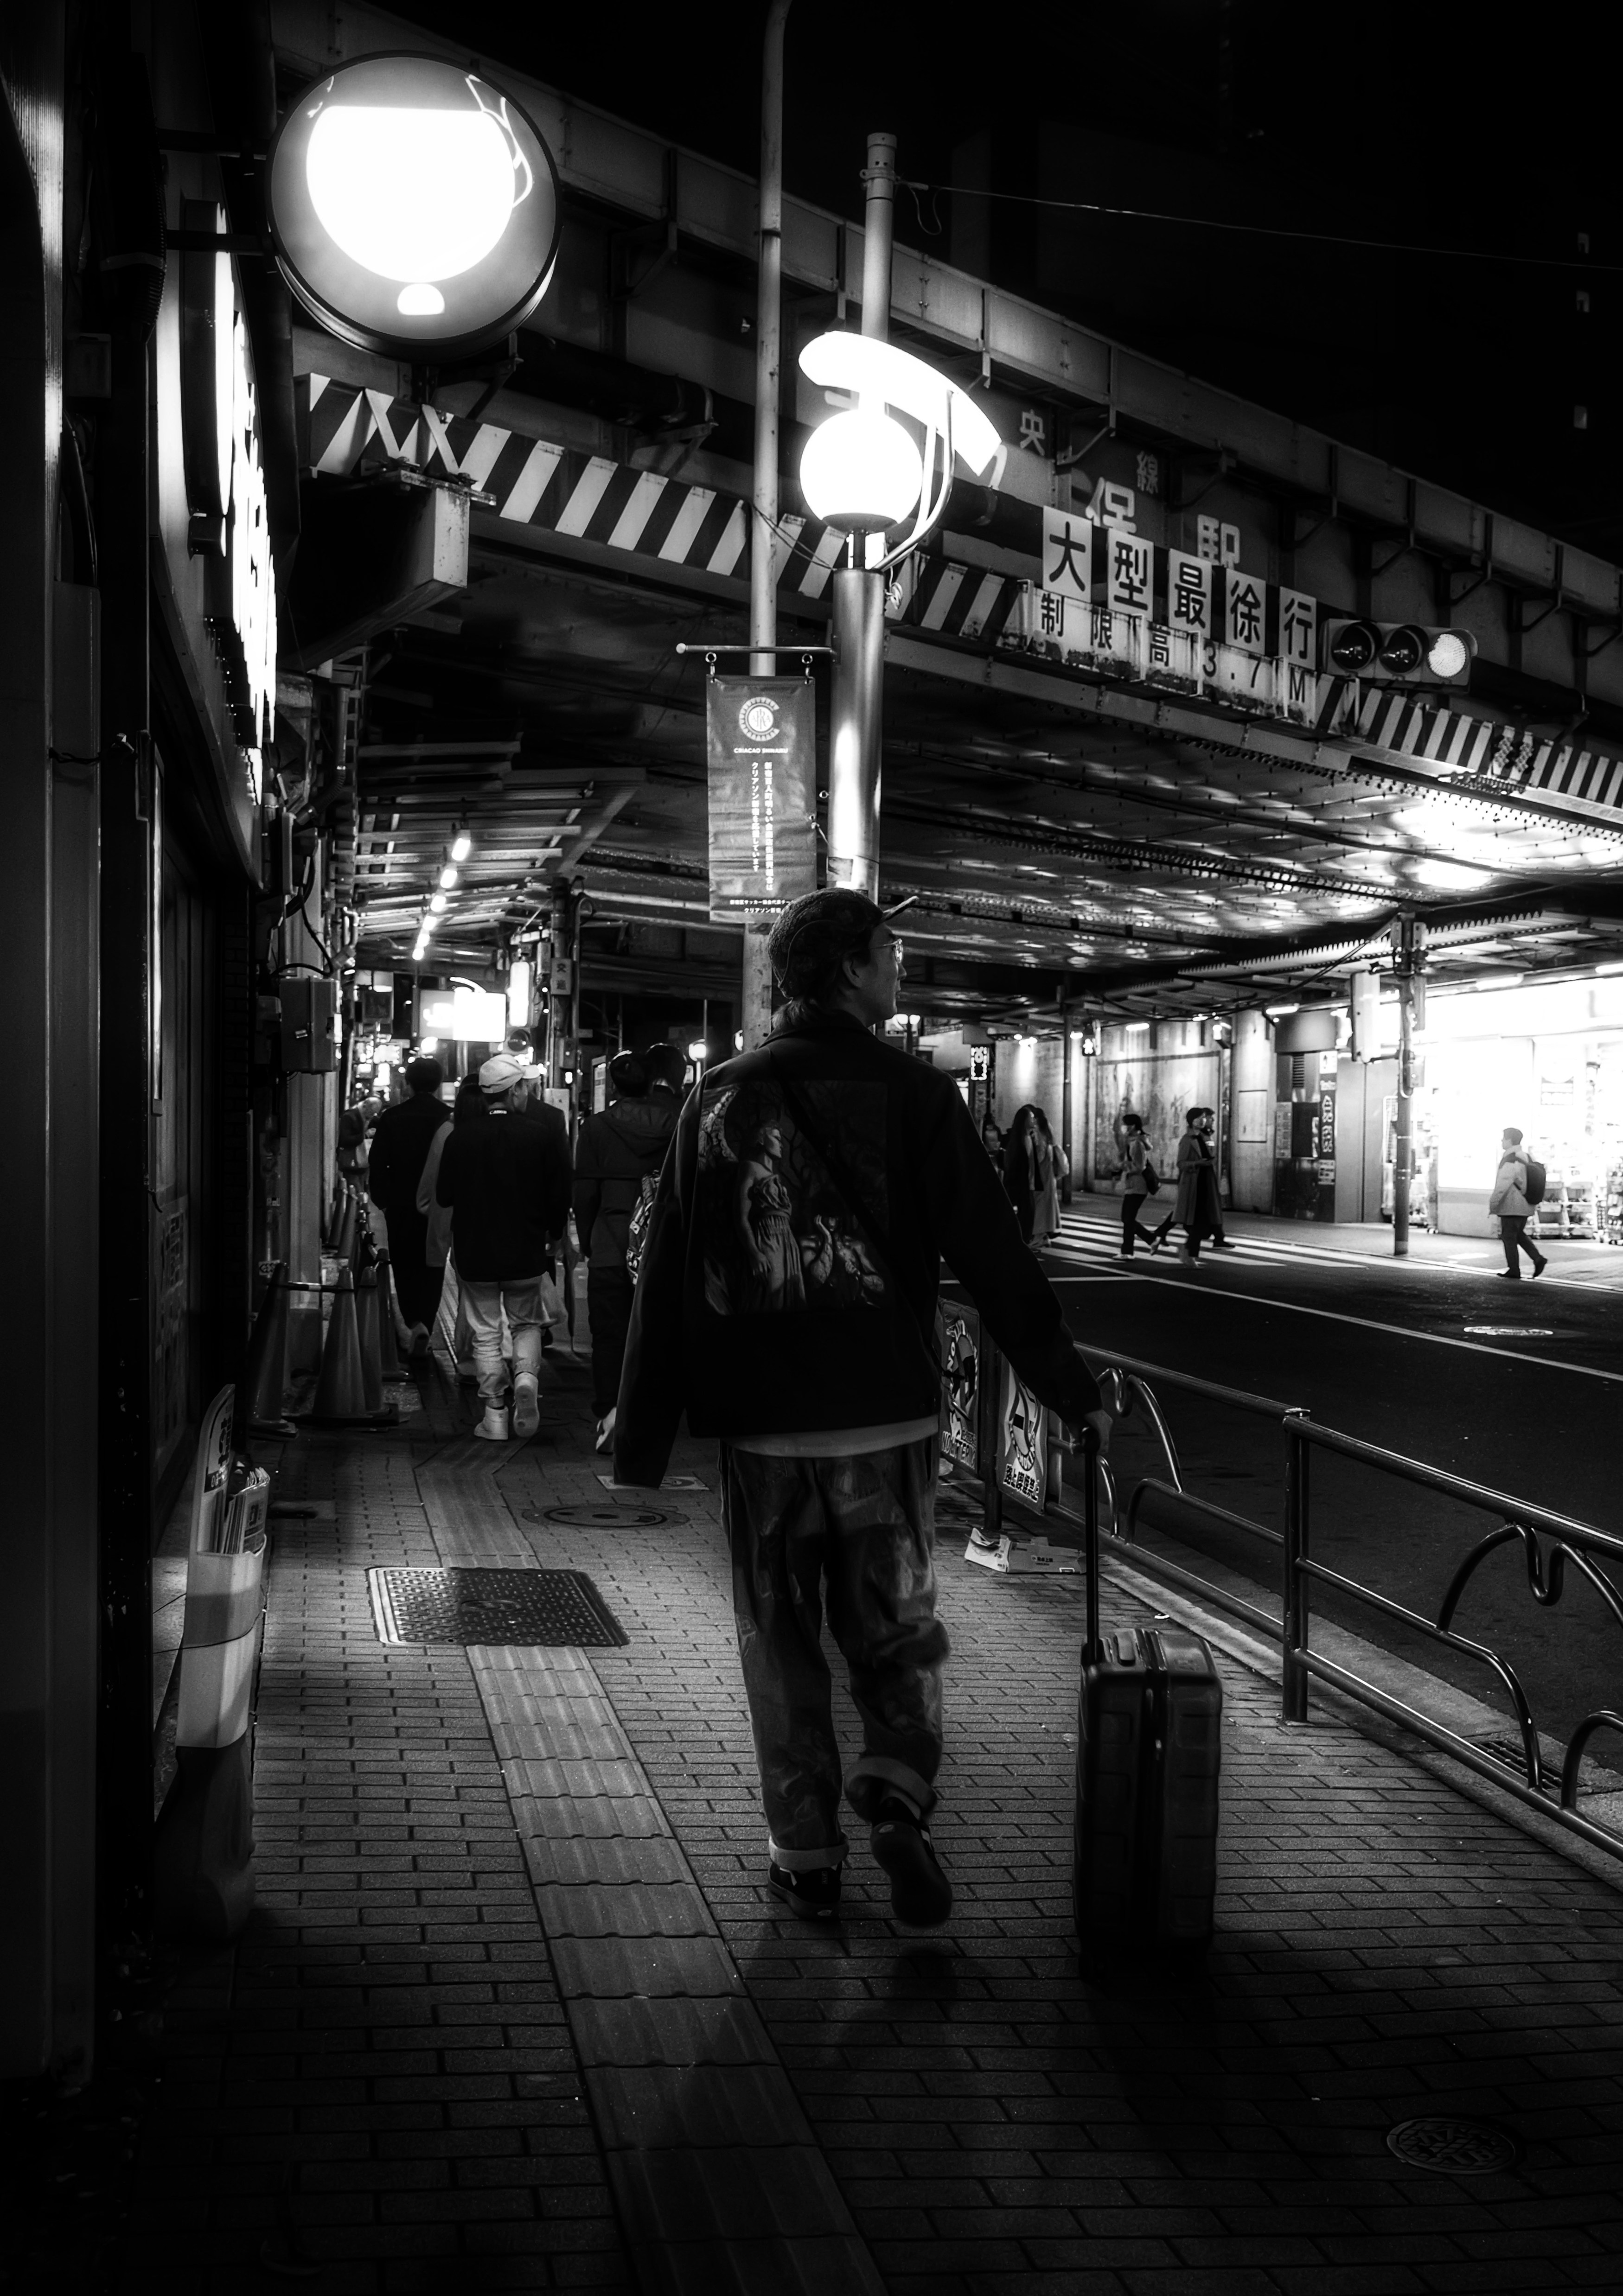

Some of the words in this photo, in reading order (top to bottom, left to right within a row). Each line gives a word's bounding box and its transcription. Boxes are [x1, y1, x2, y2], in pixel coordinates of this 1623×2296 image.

[1049, 521, 1313, 660] 大型最徐行
[751, 762, 760, 872] クリアソン新宿を応しています
